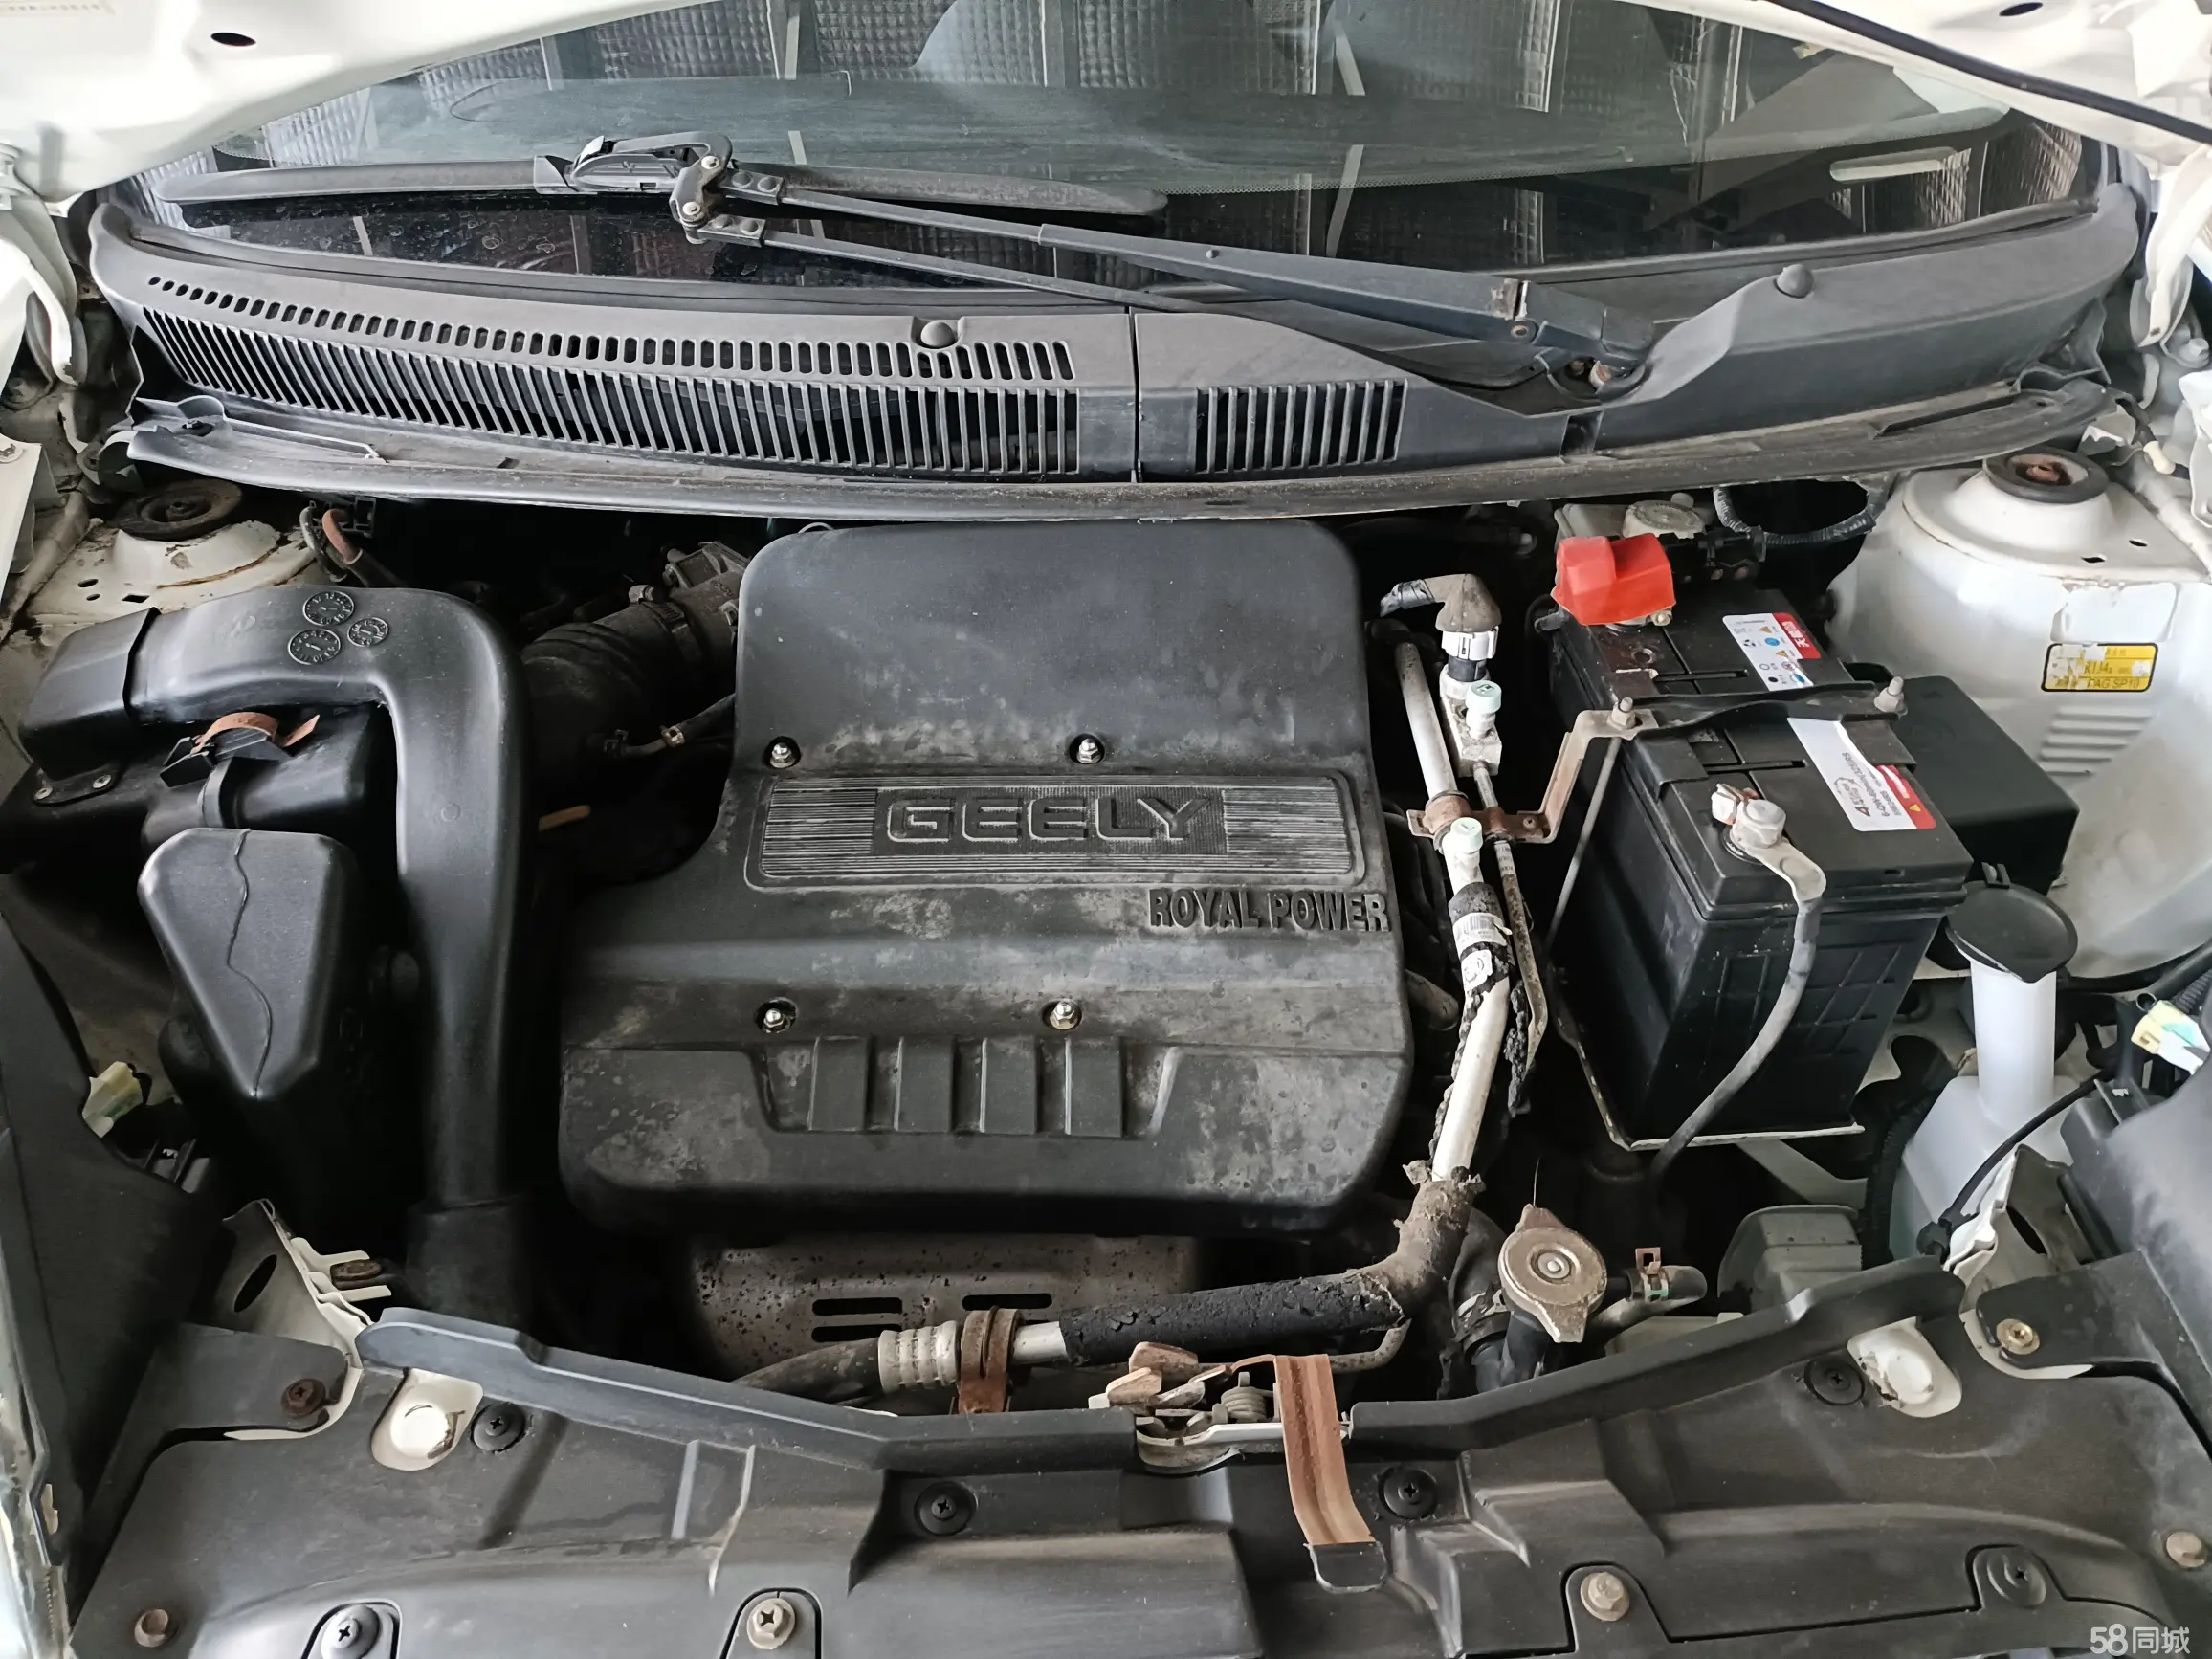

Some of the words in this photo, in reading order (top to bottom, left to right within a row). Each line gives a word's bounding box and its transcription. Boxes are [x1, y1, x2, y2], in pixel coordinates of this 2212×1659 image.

[886, 795, 1211, 844] GEELY
[1149, 888, 1261, 929] ROYAL
[1268, 890, 1389, 932] POWER
